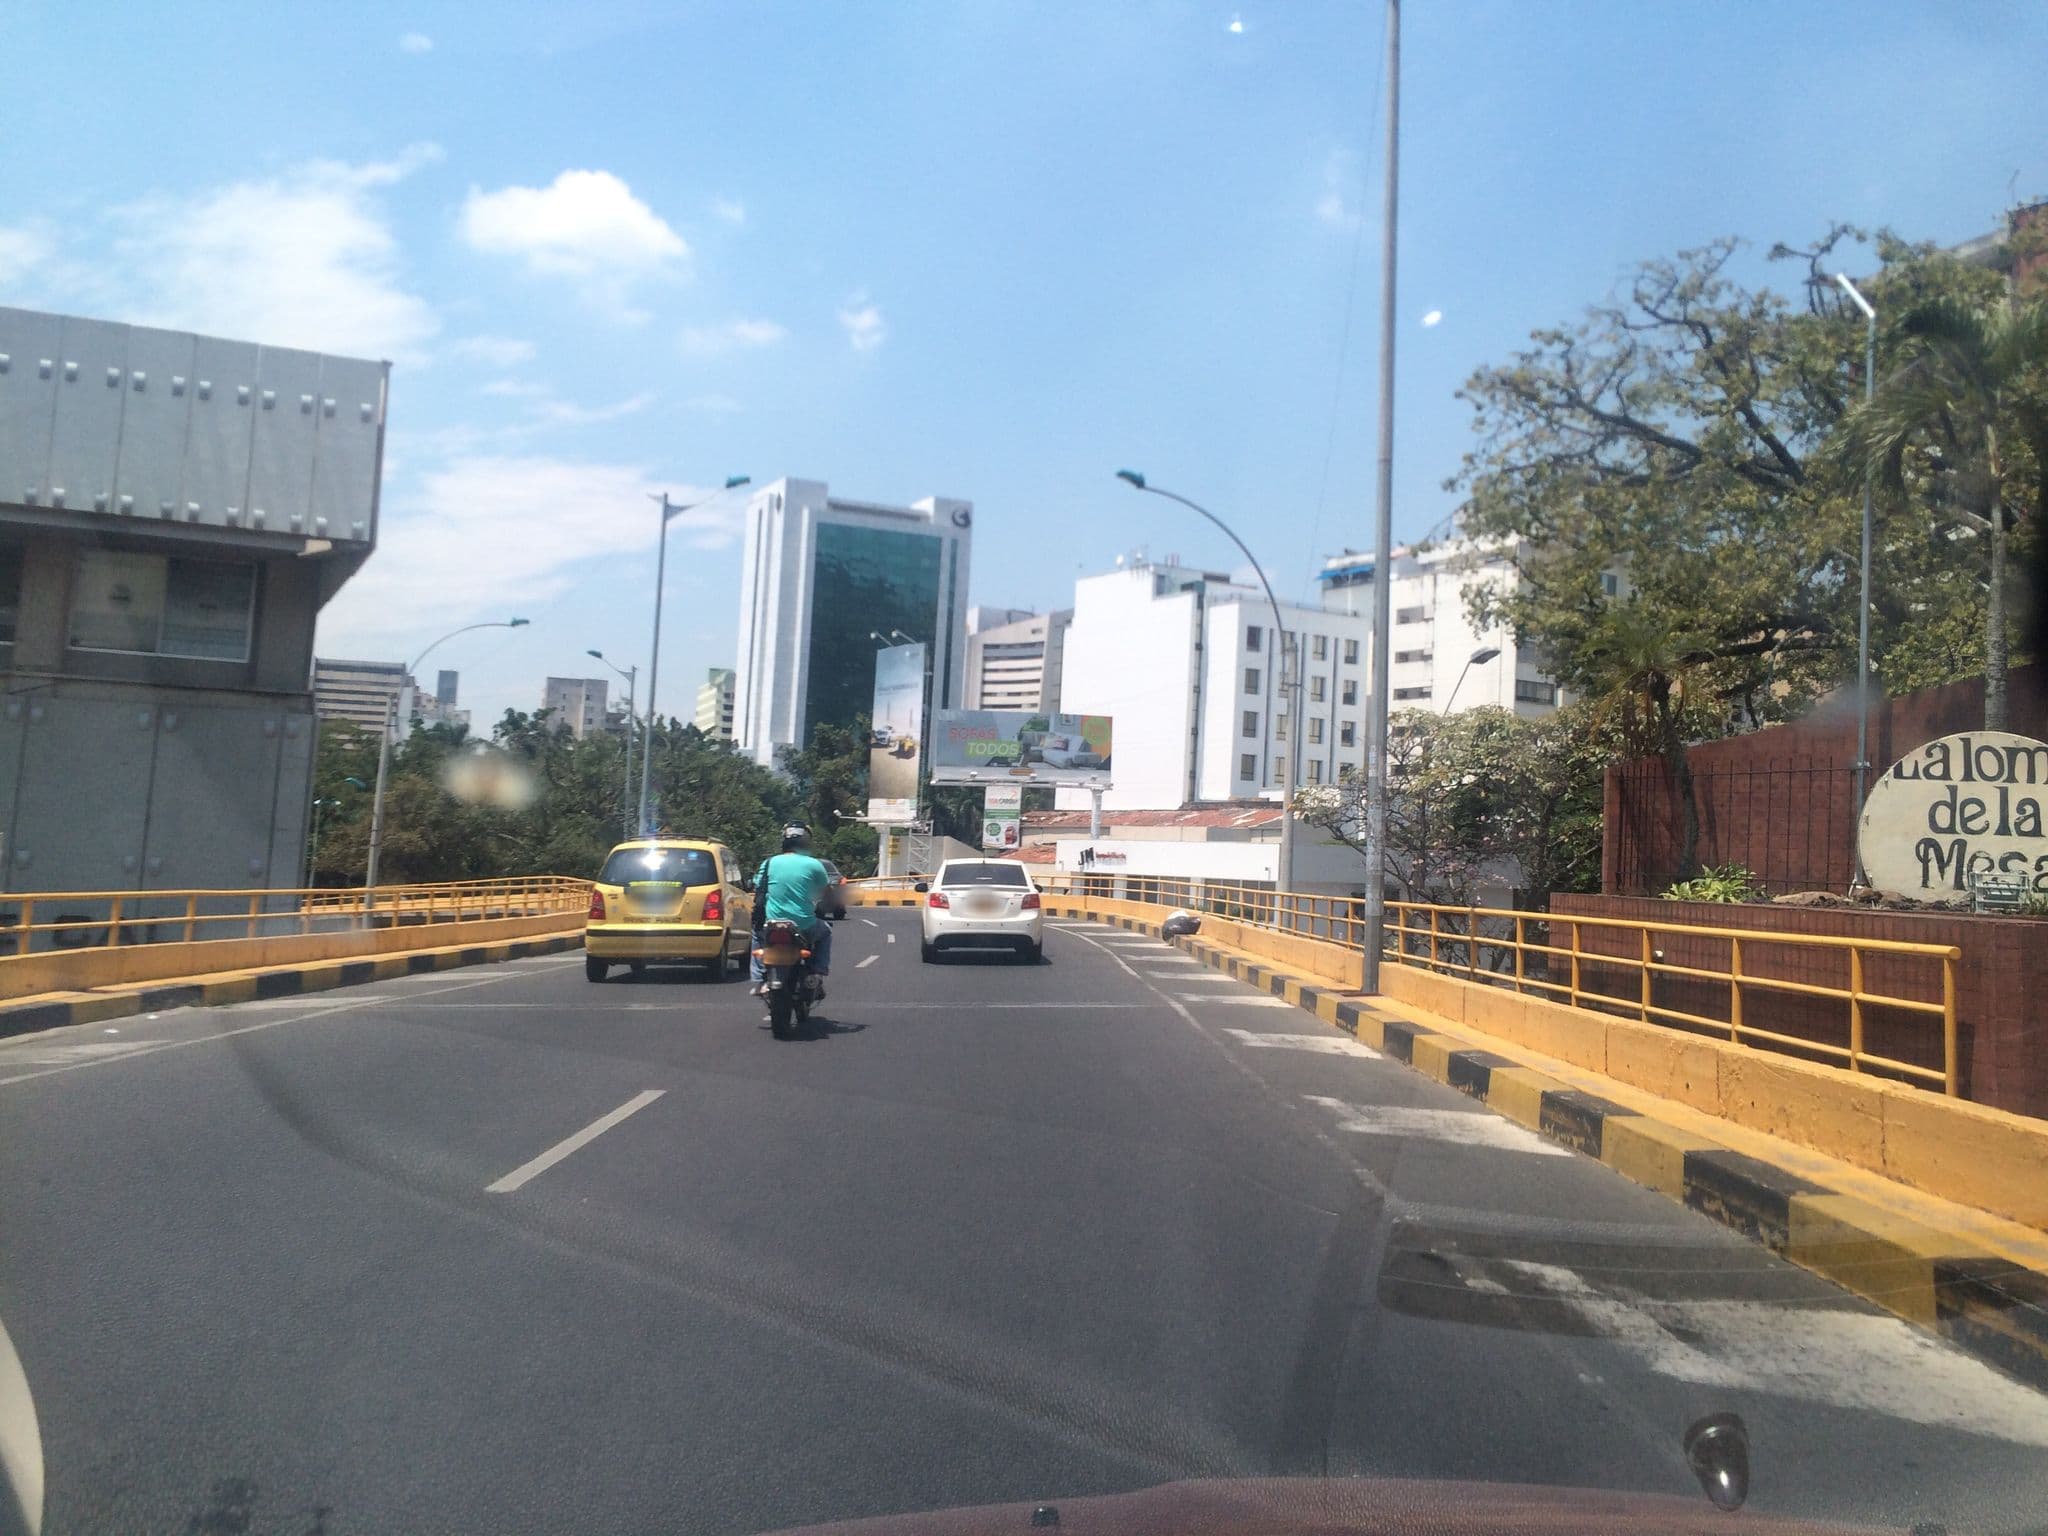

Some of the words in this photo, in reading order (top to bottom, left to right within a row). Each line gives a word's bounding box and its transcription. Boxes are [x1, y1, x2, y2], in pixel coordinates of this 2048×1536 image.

[966, 741, 1020, 755] TODOS
[1928, 784, 1989, 835] de
[1992, 785, 2047, 837] la
